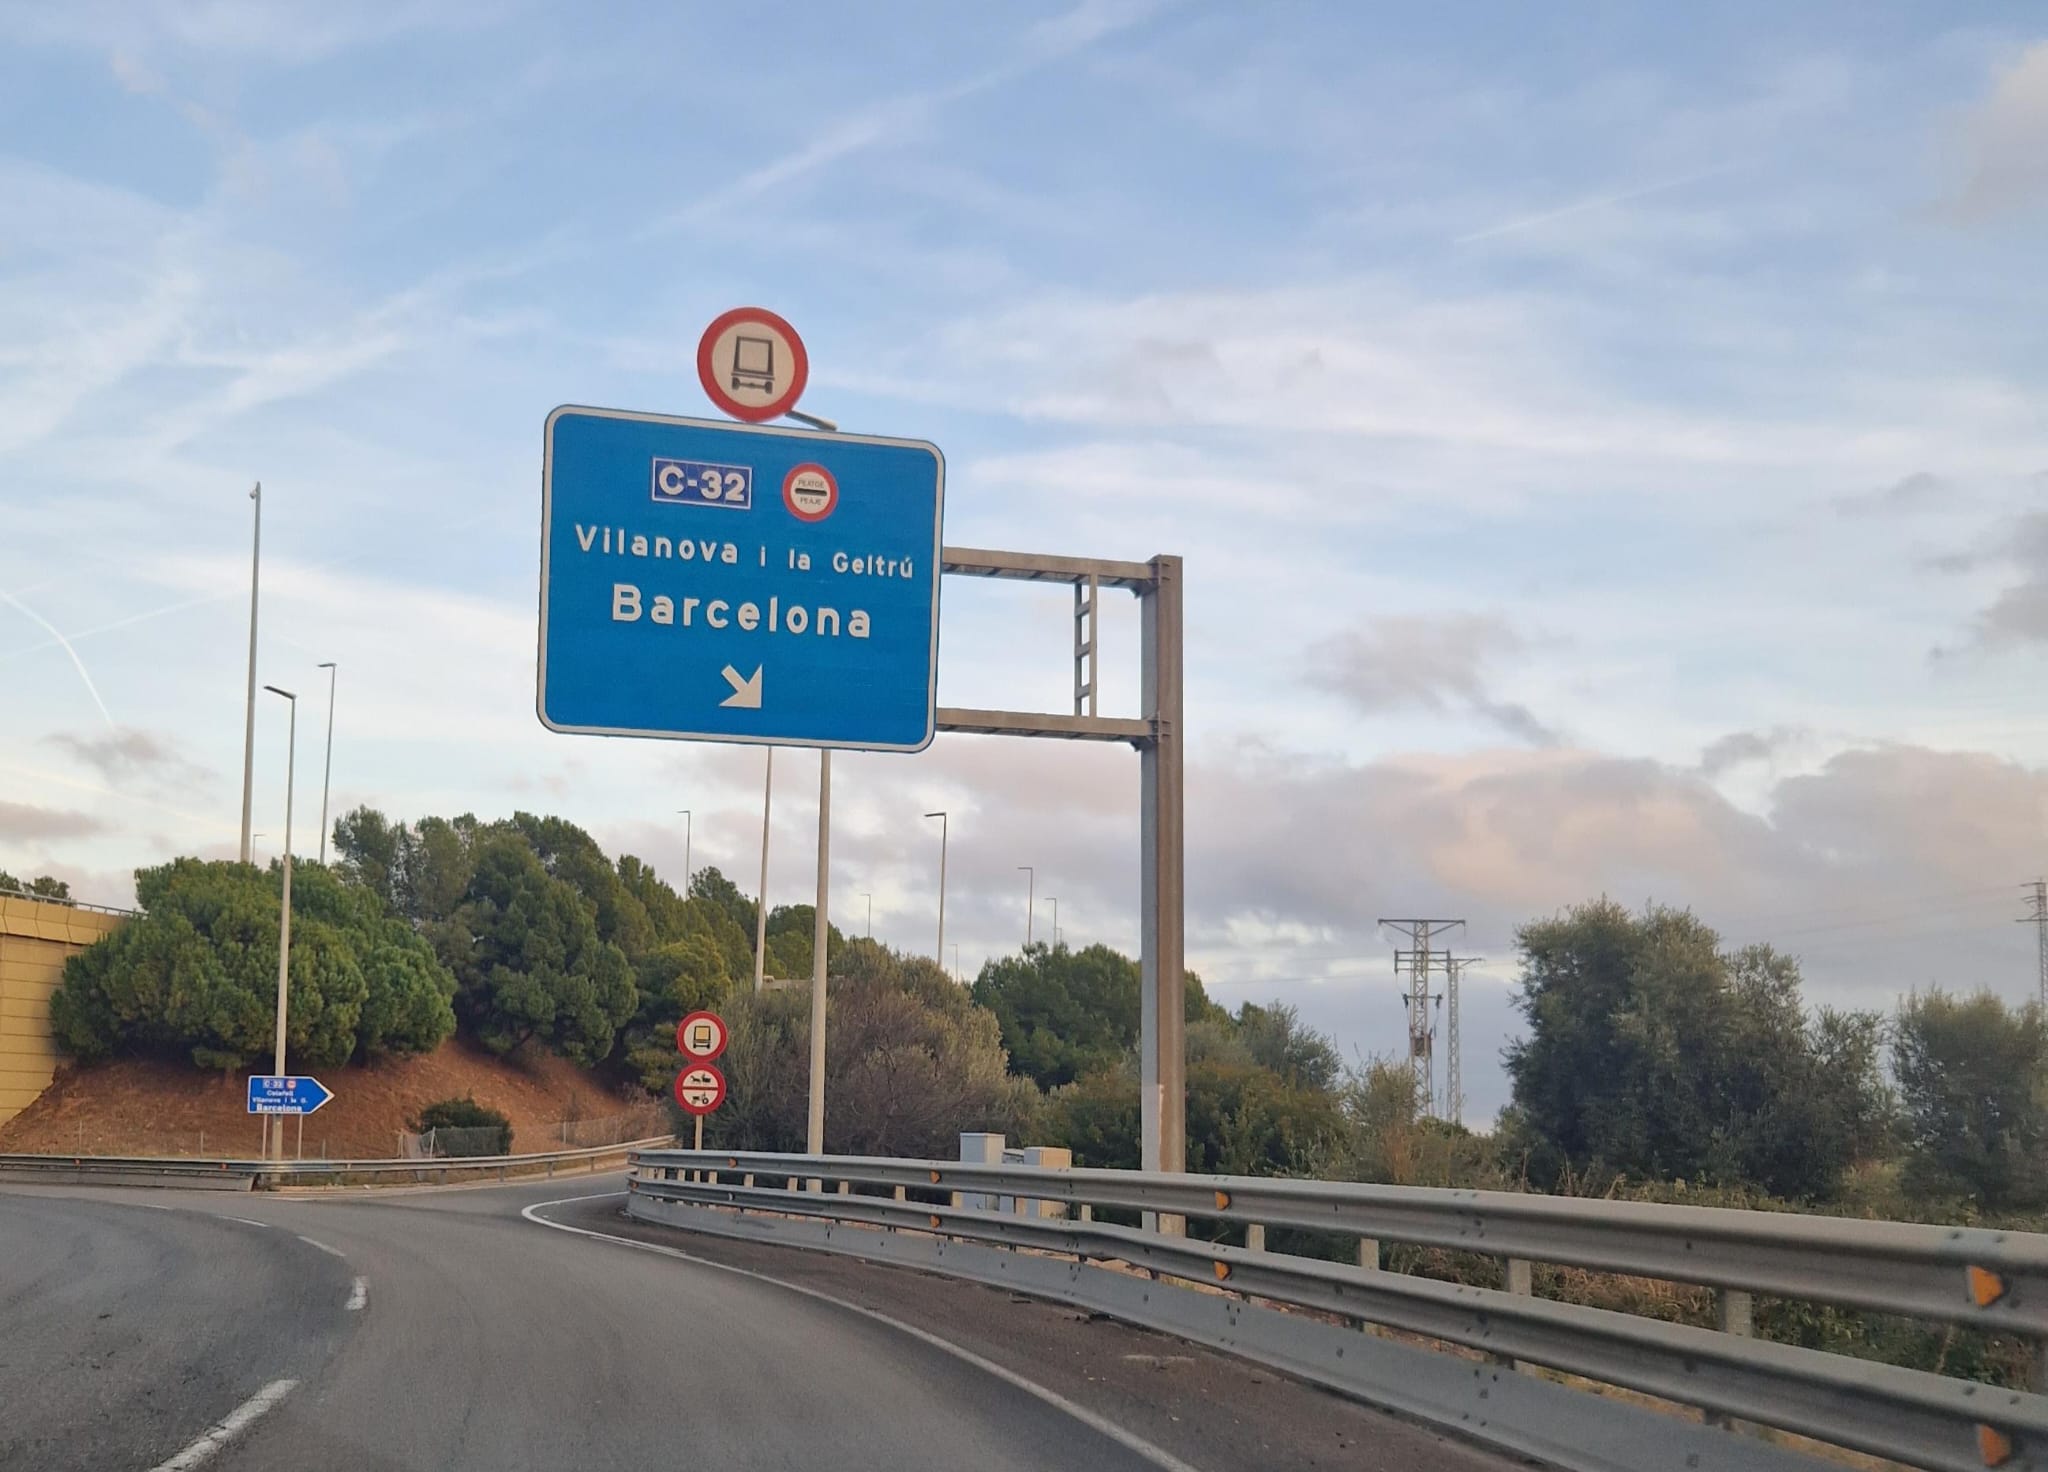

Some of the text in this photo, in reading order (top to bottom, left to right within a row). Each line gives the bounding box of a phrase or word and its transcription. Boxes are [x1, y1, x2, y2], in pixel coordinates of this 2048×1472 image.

[658, 465, 746, 502] C-32
[800, 497, 822, 506] PEAJE
[575, 524, 914, 579] Vilanova i la Geltrú
[612, 583, 871, 639] Barcelona
[256, 1103, 302, 1112] Barcelona
